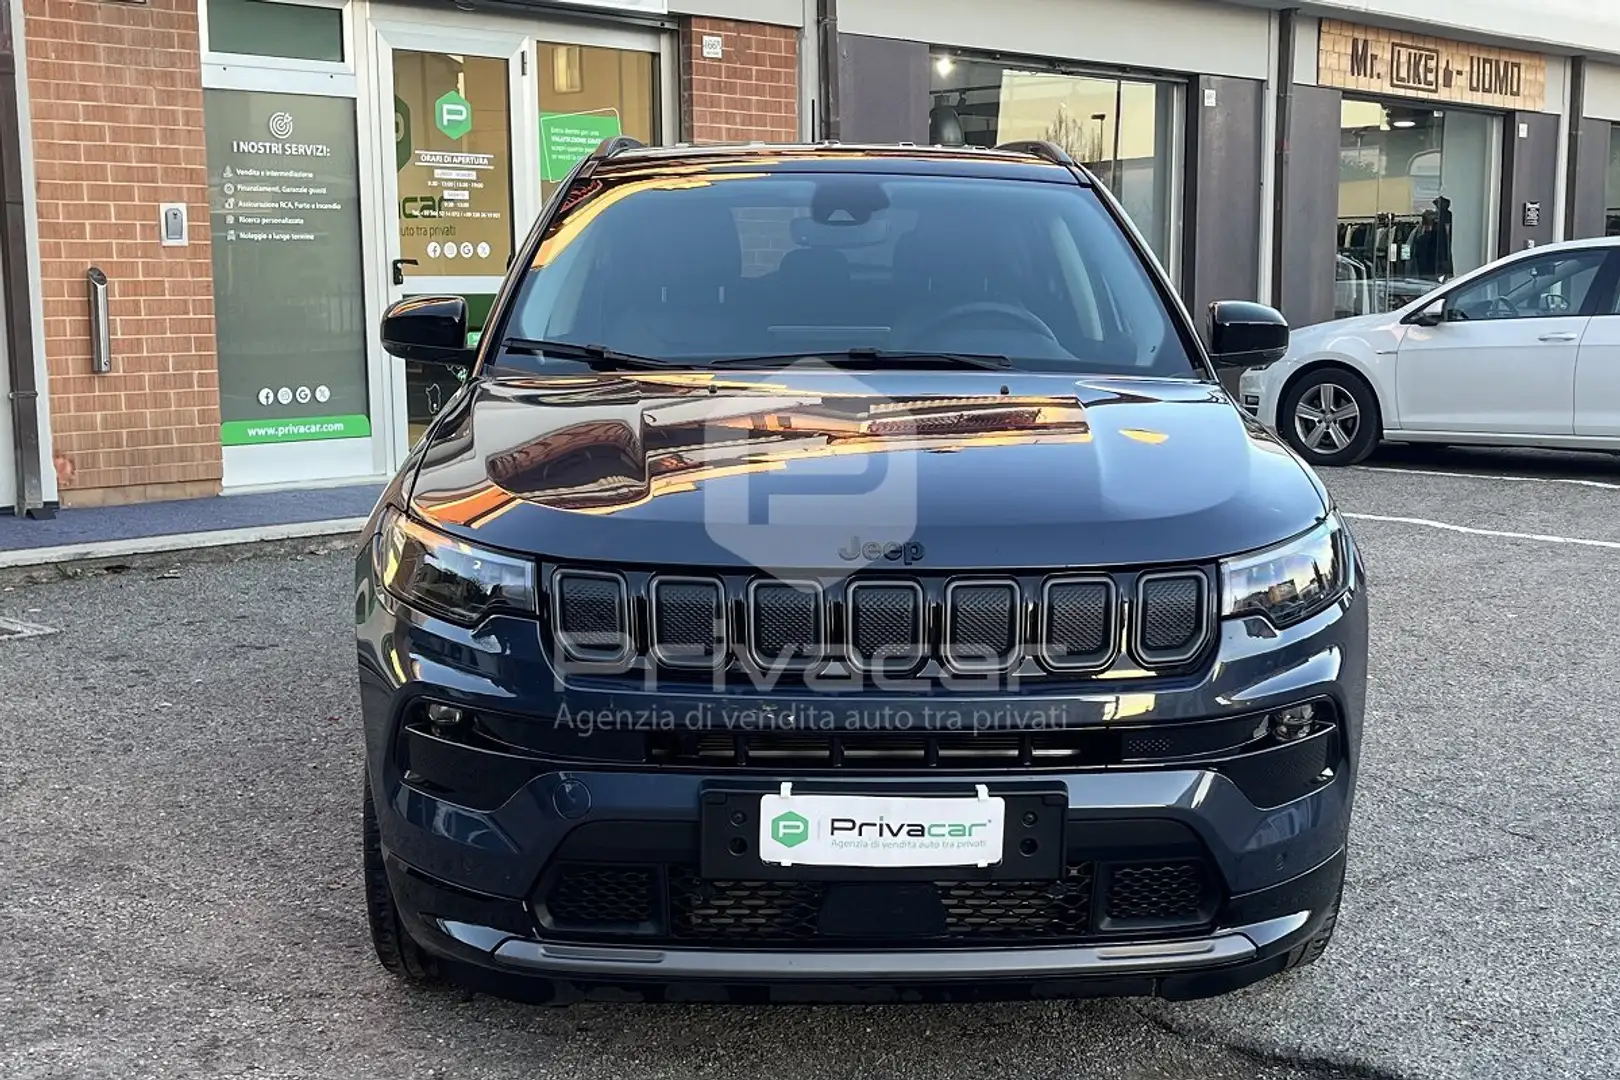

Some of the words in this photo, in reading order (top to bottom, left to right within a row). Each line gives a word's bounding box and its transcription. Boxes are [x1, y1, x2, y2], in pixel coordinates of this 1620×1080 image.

[1350, 38, 1381, 79] Mr.
[1396, 49, 1435, 87] LIKE
[1469, 56, 1521, 97] UOMO
[233, 141, 238, 153] I
[240, 141, 282, 154] NOSTRI
[284, 144, 331, 157] SERVIZI:
[420, 154, 443, 163] ORARI
[444, 155, 452, 163] DI
[452, 156, 489, 165] APERTURA
[399, 196, 455, 219] car
[400, 226, 414, 237] uto
[429, 224, 456, 239] privati
[247, 422, 344, 437] www.privacar.com
[837, 535, 925, 566] Jeep
[830, 815, 987, 838] Privacar
[831, 839, 868, 849] Agenzia
[871, 839, 880, 848] di
[882, 839, 917, 848] vendita
[956, 840, 987, 849] privati
